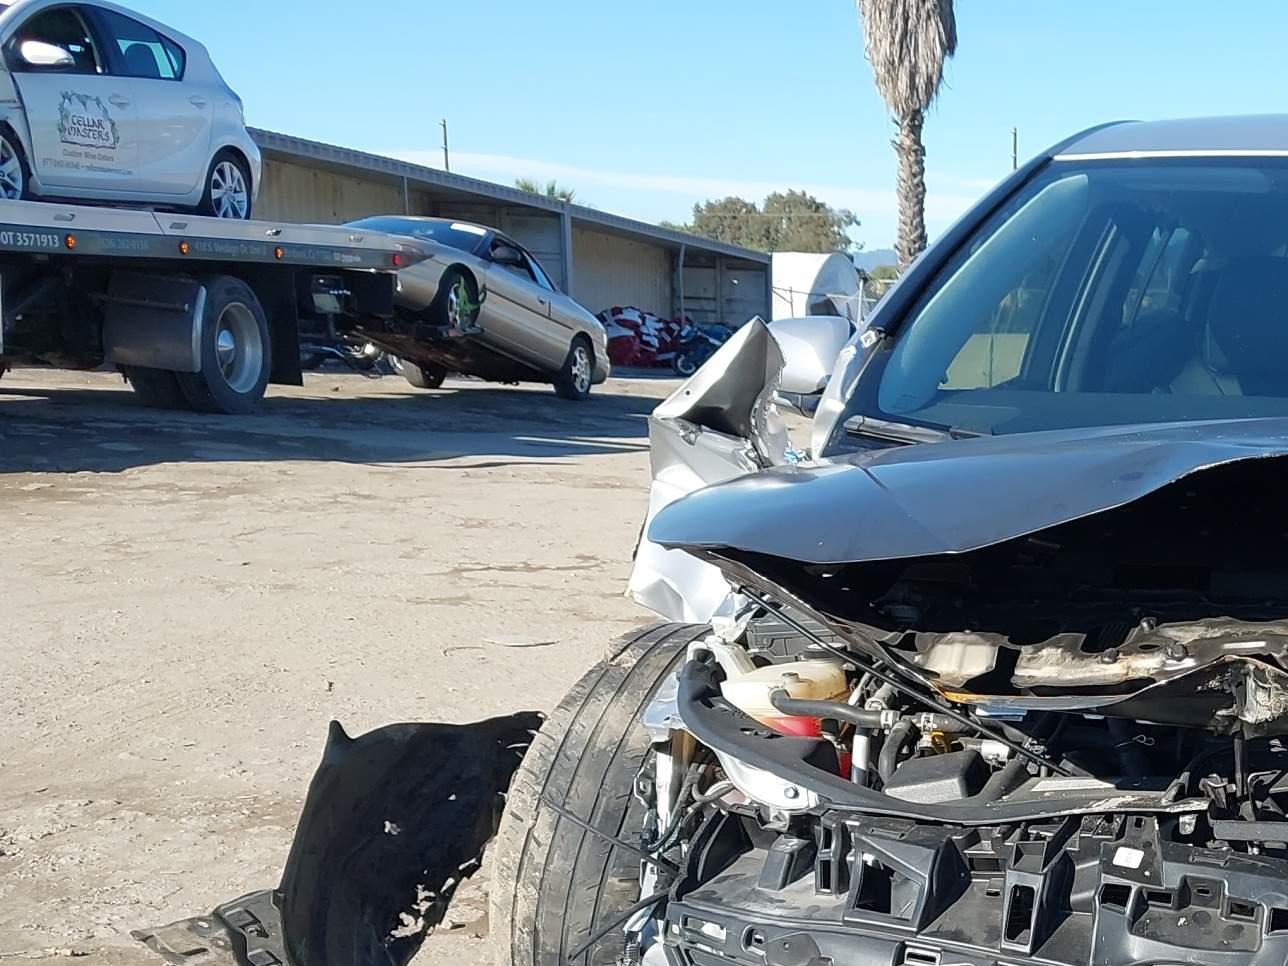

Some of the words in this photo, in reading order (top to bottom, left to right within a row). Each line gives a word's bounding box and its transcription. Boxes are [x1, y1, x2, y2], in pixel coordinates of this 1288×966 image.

[71, 115, 106, 130] CELLAR
[67, 127, 110, 142] MASTERS
[16, 232, 59, 248] 3571913
